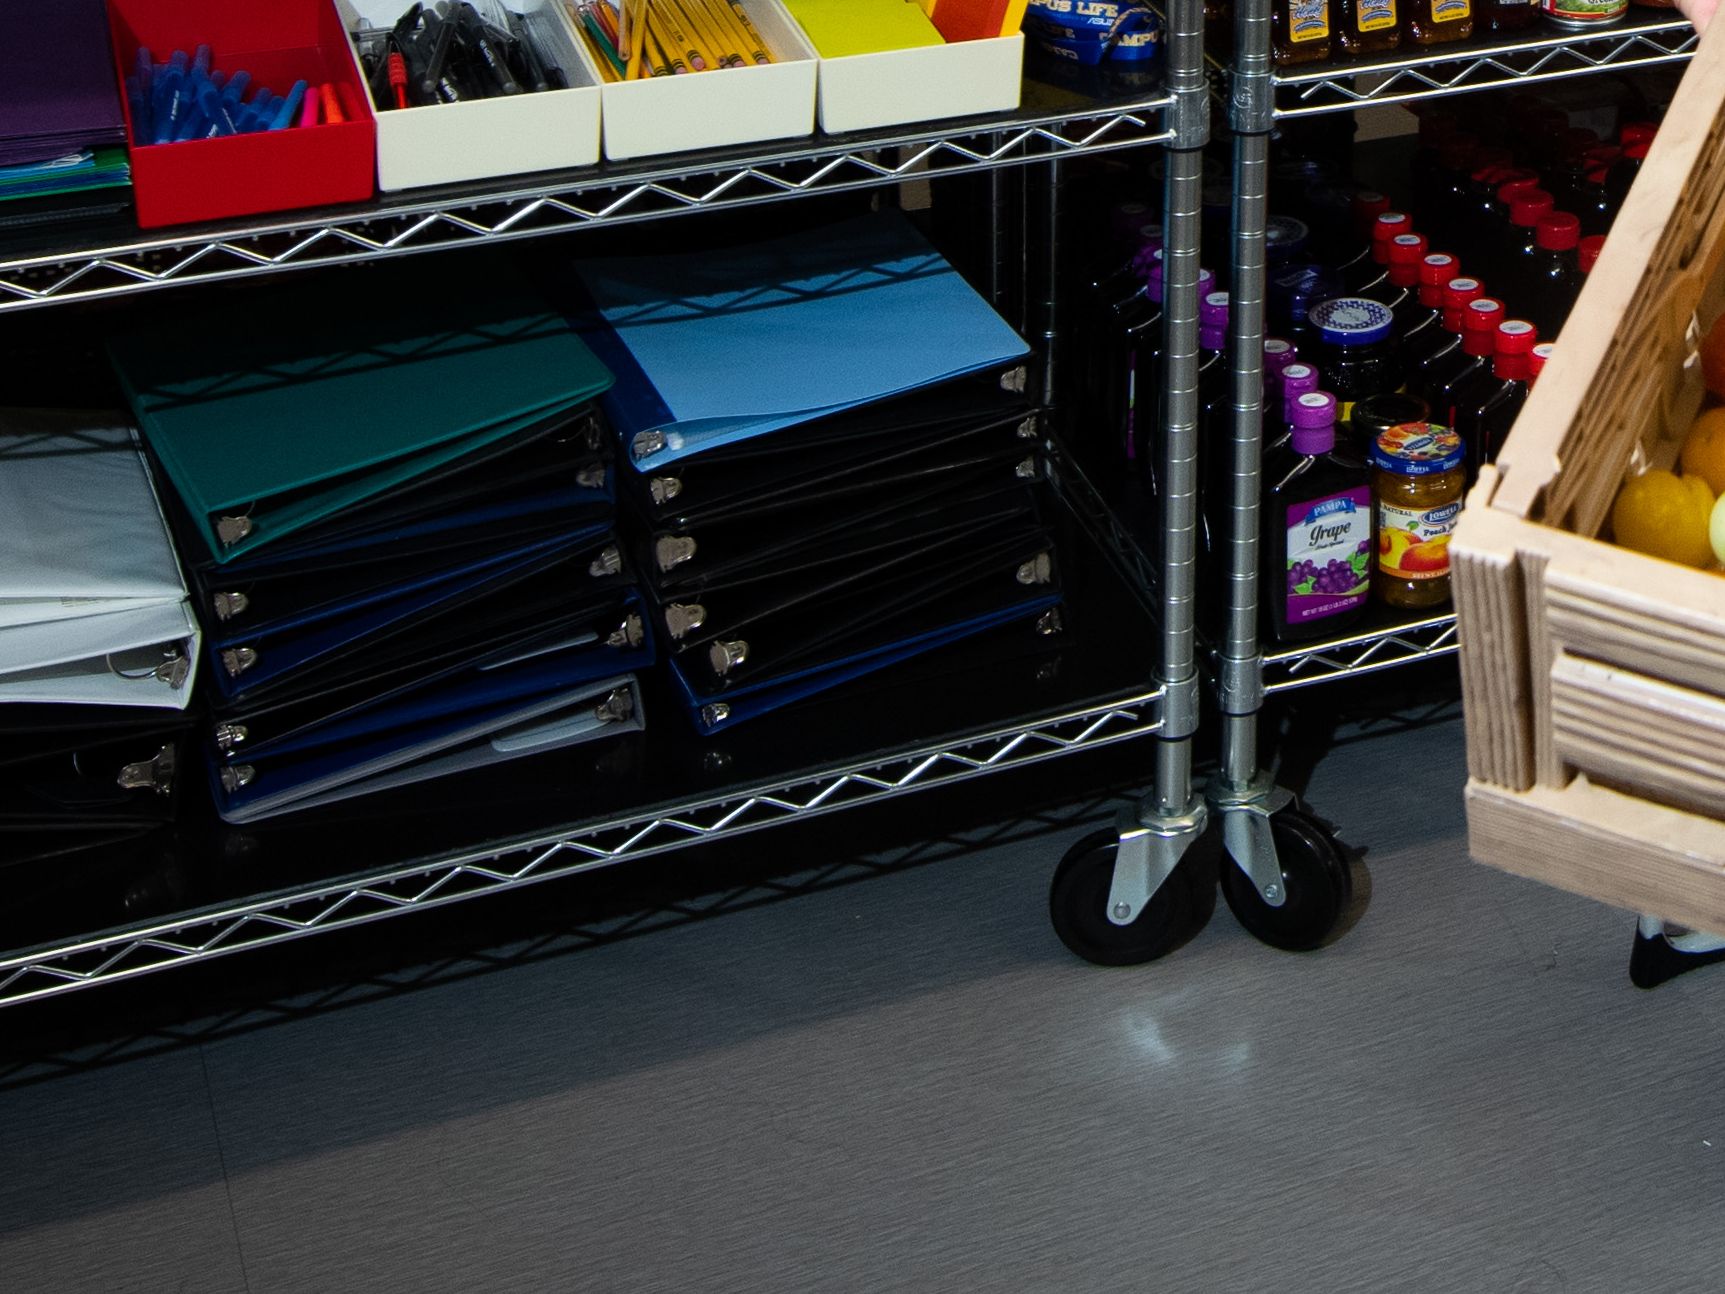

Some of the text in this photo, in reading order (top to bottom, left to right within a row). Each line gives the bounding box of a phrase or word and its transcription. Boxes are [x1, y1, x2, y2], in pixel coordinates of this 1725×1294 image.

[1076, 0, 1120, 17] LIFE
[1313, 499, 1348, 517] PAMPA
[1423, 525, 1448, 537] Peach
